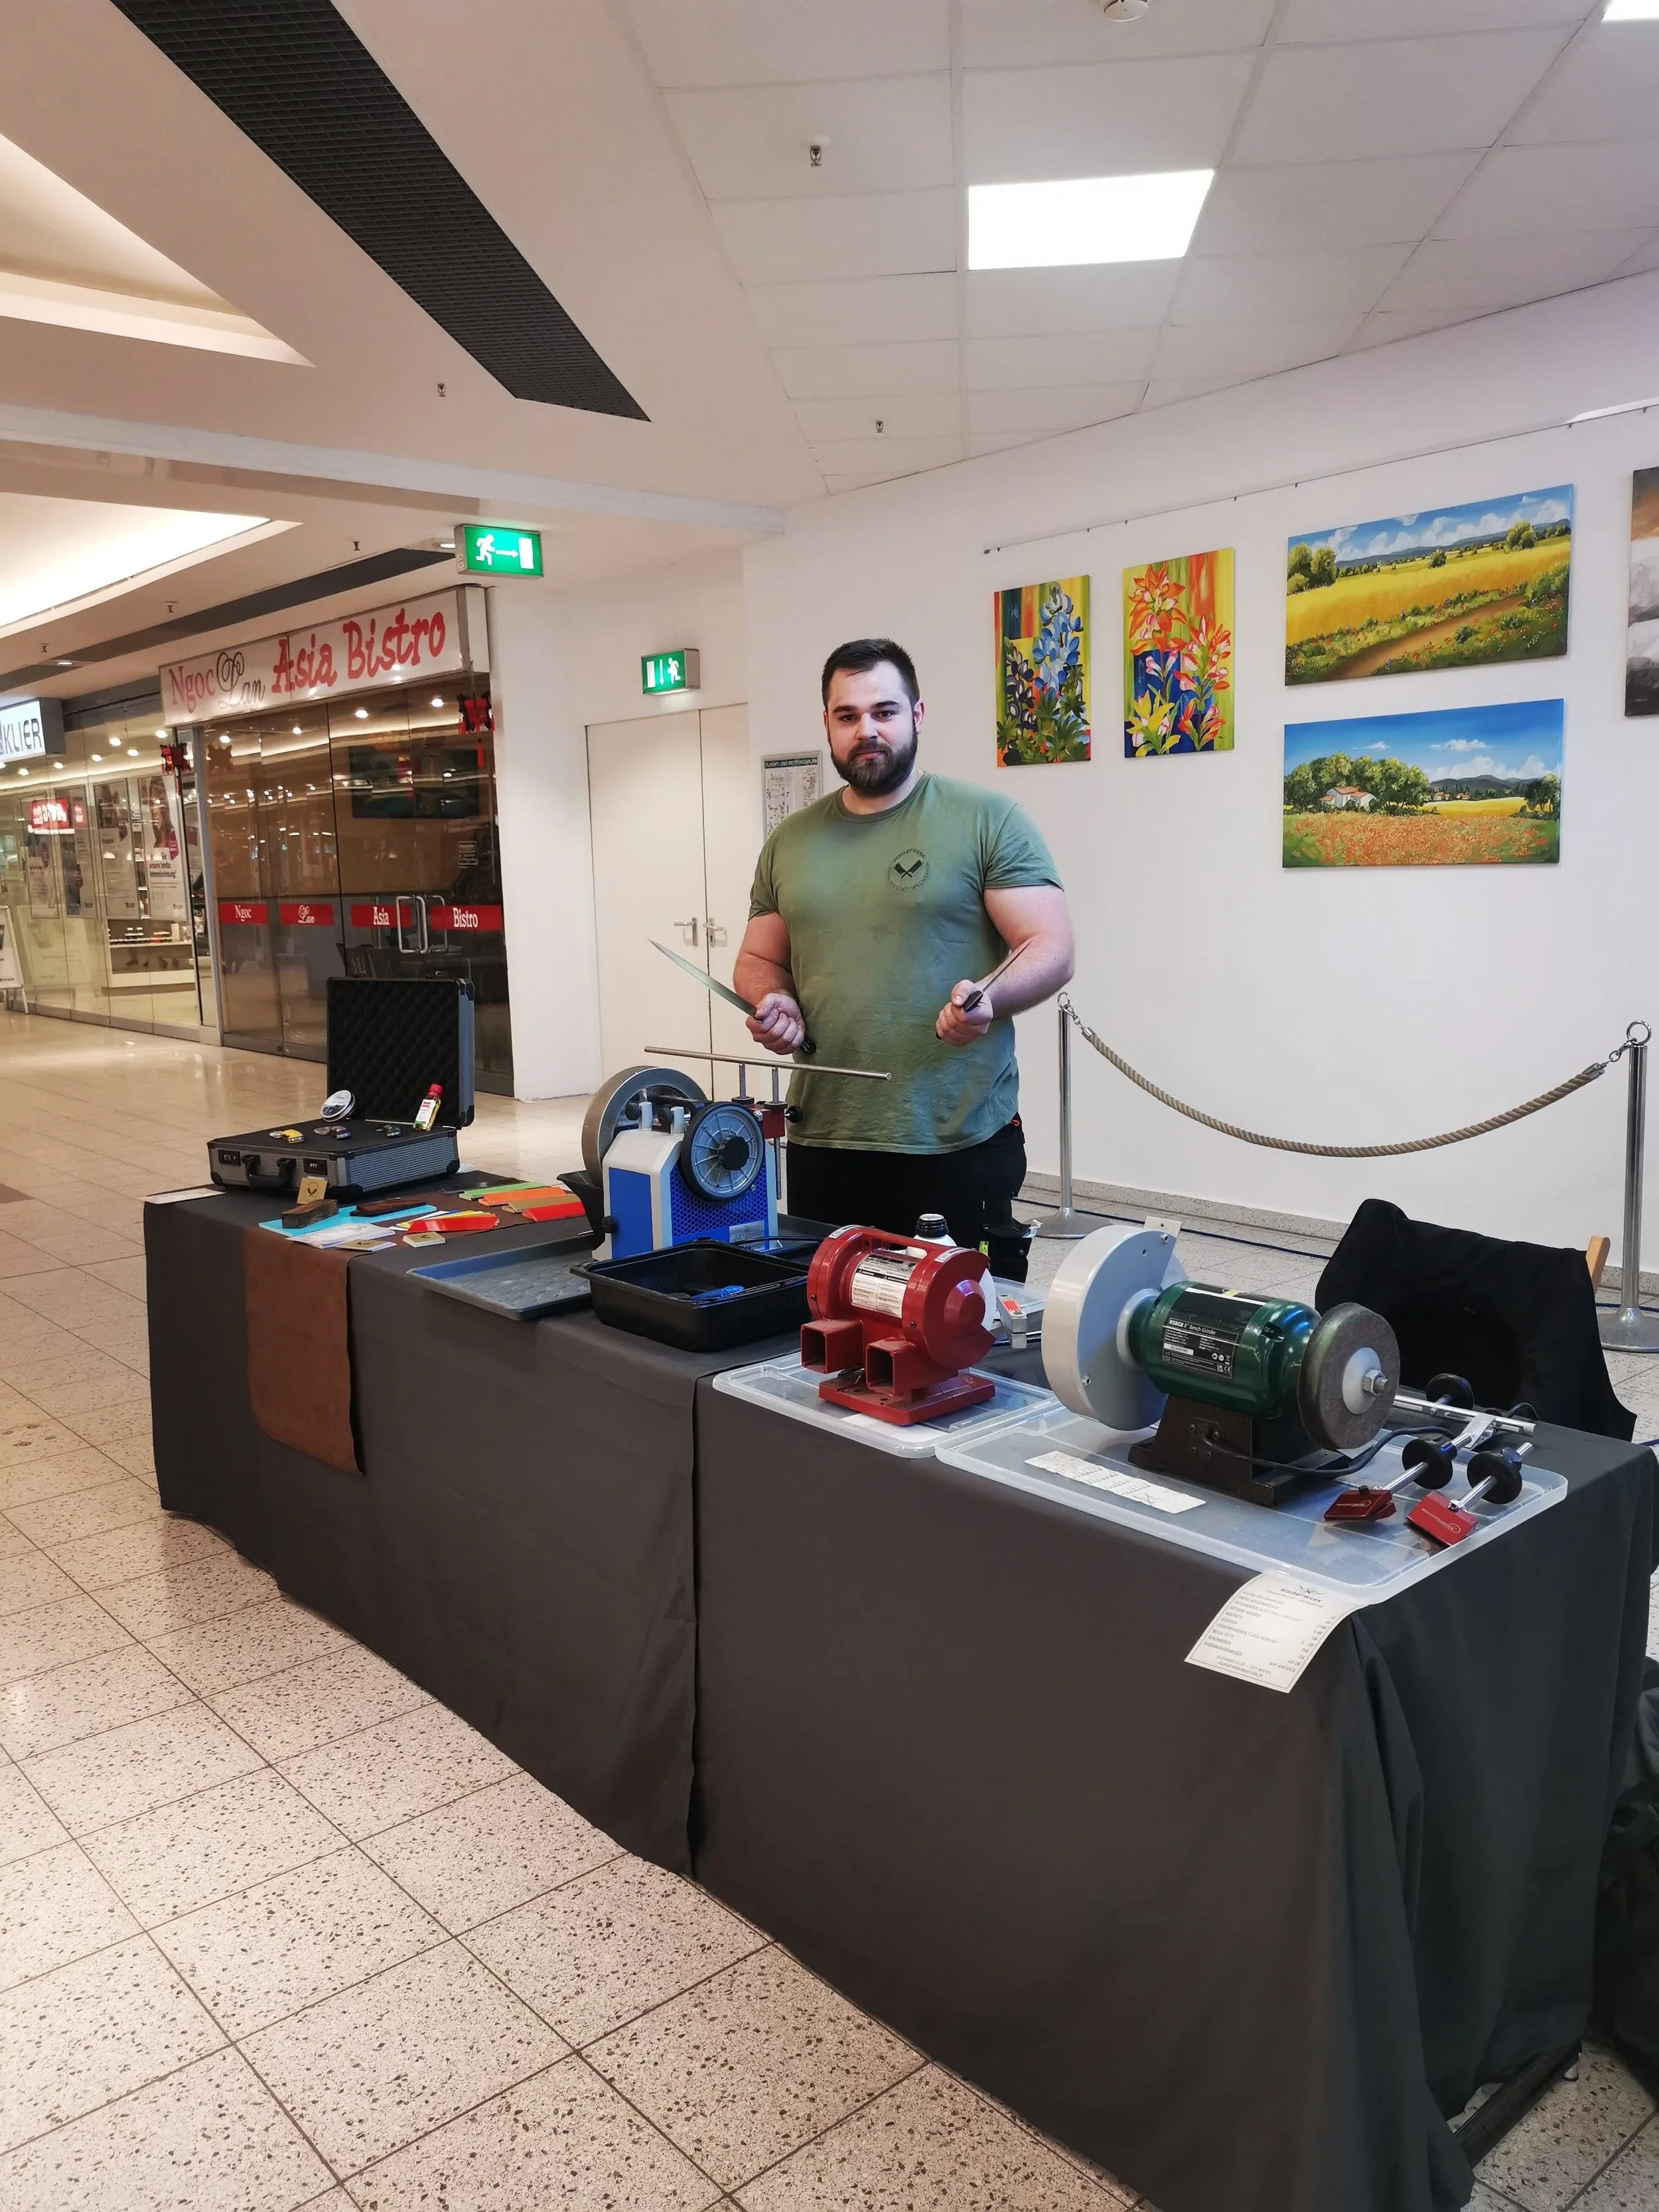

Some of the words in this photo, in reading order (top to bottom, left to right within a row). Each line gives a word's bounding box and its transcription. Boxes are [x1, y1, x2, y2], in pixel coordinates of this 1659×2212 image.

[169, 665, 215, 713] Ngoc
[217, 652, 265, 709] Lan
[272, 634, 338, 694] Asia
[343, 607, 446, 680] Bistro
[3, 718, 42, 754] KLIER
[235, 905, 252, 922] Ngoc
[373, 907, 390, 926] Asia
[453, 907, 478, 928] Bistro
